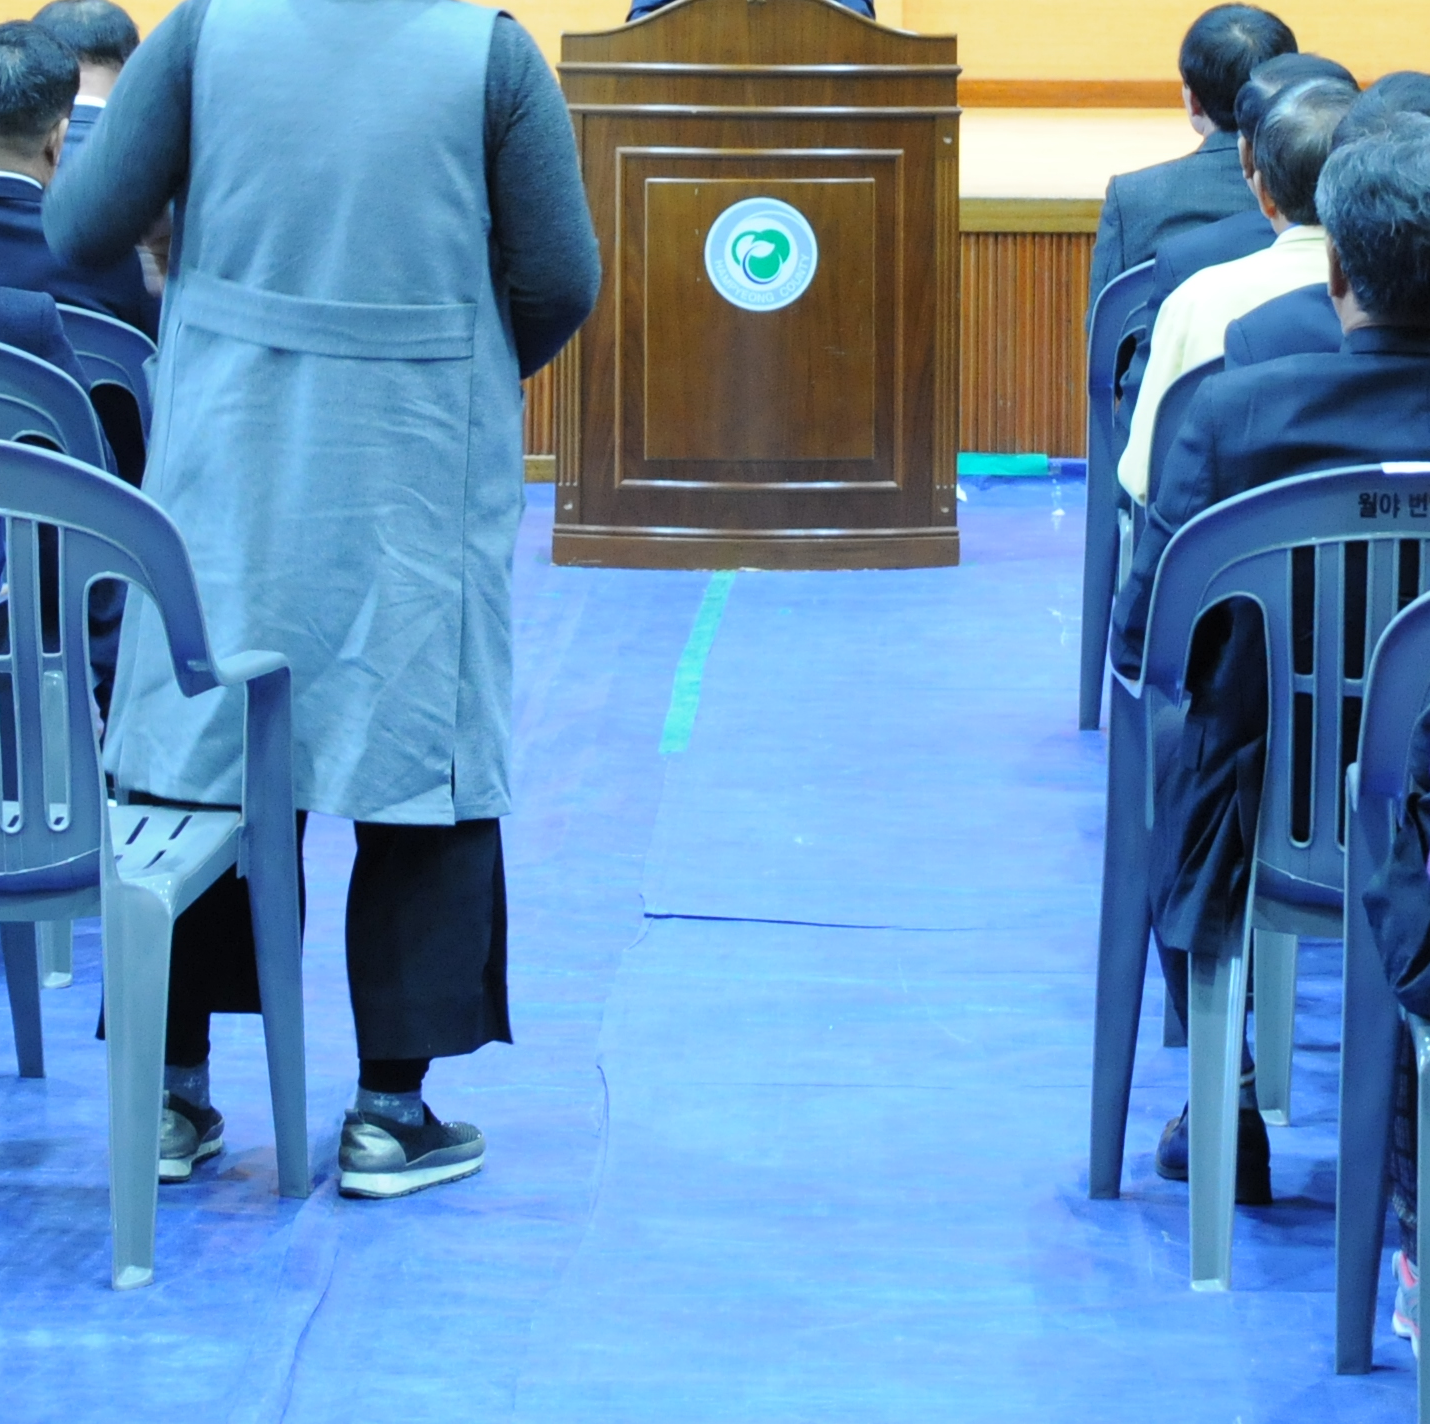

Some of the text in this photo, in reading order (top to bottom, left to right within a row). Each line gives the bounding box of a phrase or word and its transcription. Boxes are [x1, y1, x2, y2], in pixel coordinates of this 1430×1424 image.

[714, 252, 812, 304] HAMPYEONG COUNTY
[1357, 491, 1401, 519] 월야
